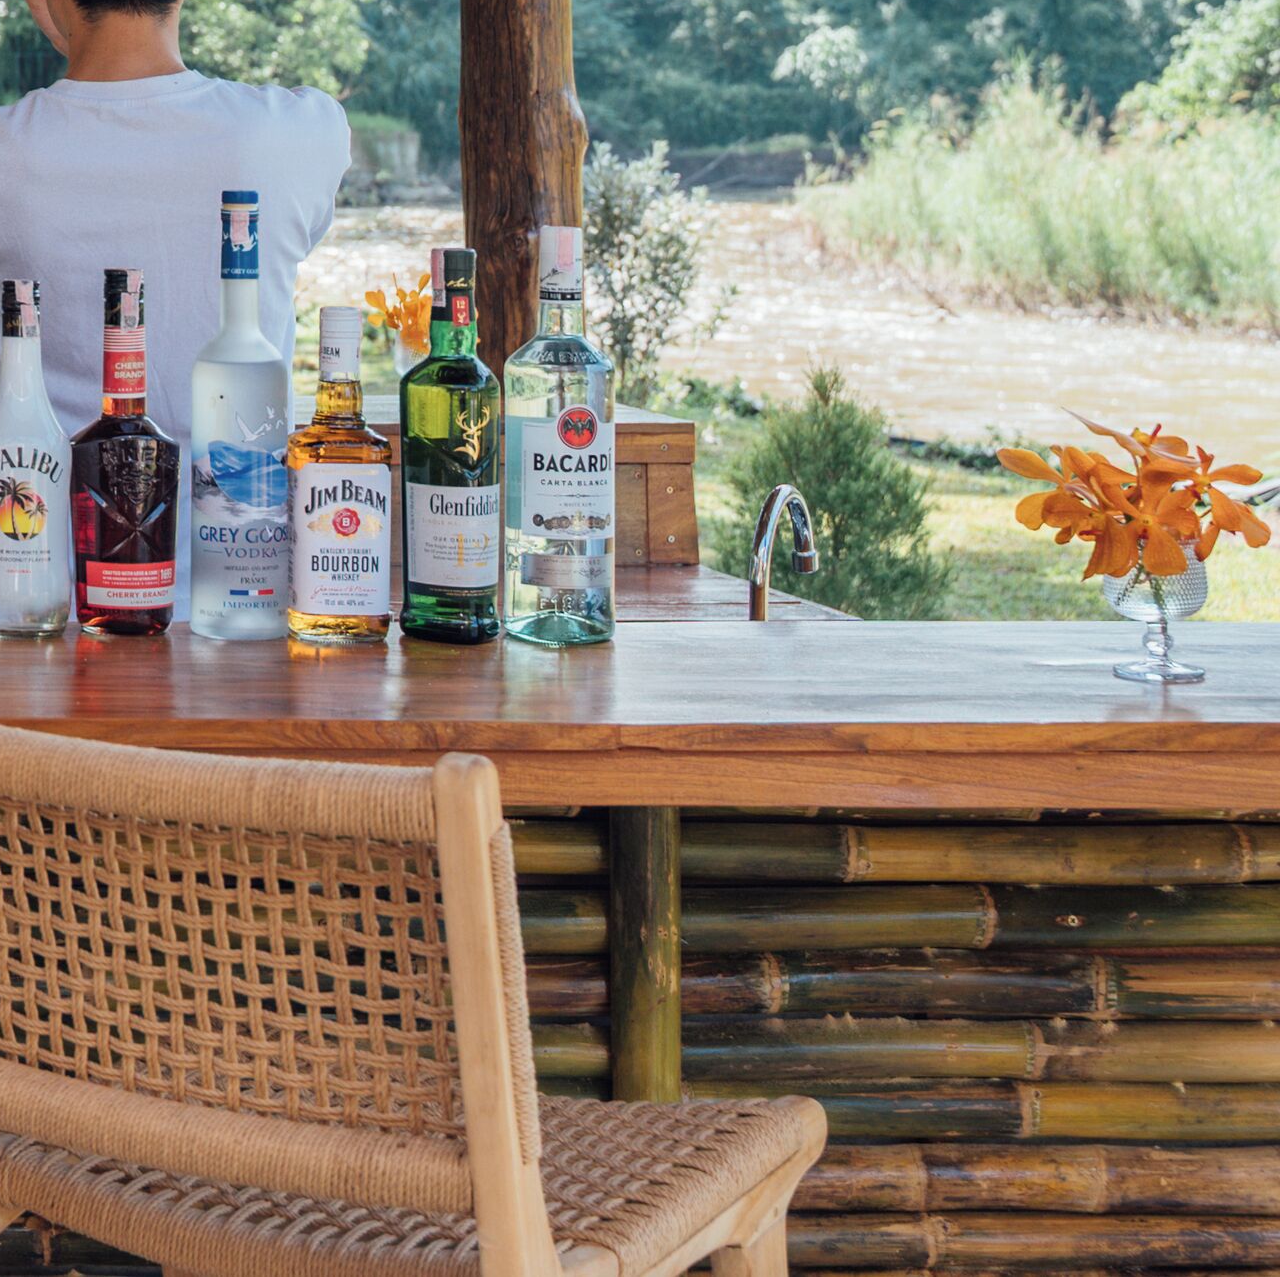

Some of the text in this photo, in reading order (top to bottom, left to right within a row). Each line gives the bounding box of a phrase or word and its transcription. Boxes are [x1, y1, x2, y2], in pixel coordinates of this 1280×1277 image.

[533, 447, 612, 473] BACARDÍ
[541, 478, 608, 487] CARTA BLANCA
[304, 479, 387, 516] JIM BEAM
[342, 517, 350, 527] B
[199, 525, 289, 544] GREY GOOS
[224, 547, 279, 559] VODKA
[311, 555, 380, 573] BOURBON
[240, 577, 267, 585] FRANCE
[331, 573, 360, 582] WHISKEY
[107, 590, 169, 599] CHERRY BRANDY
[223, 601, 279, 609] IMPORTED
